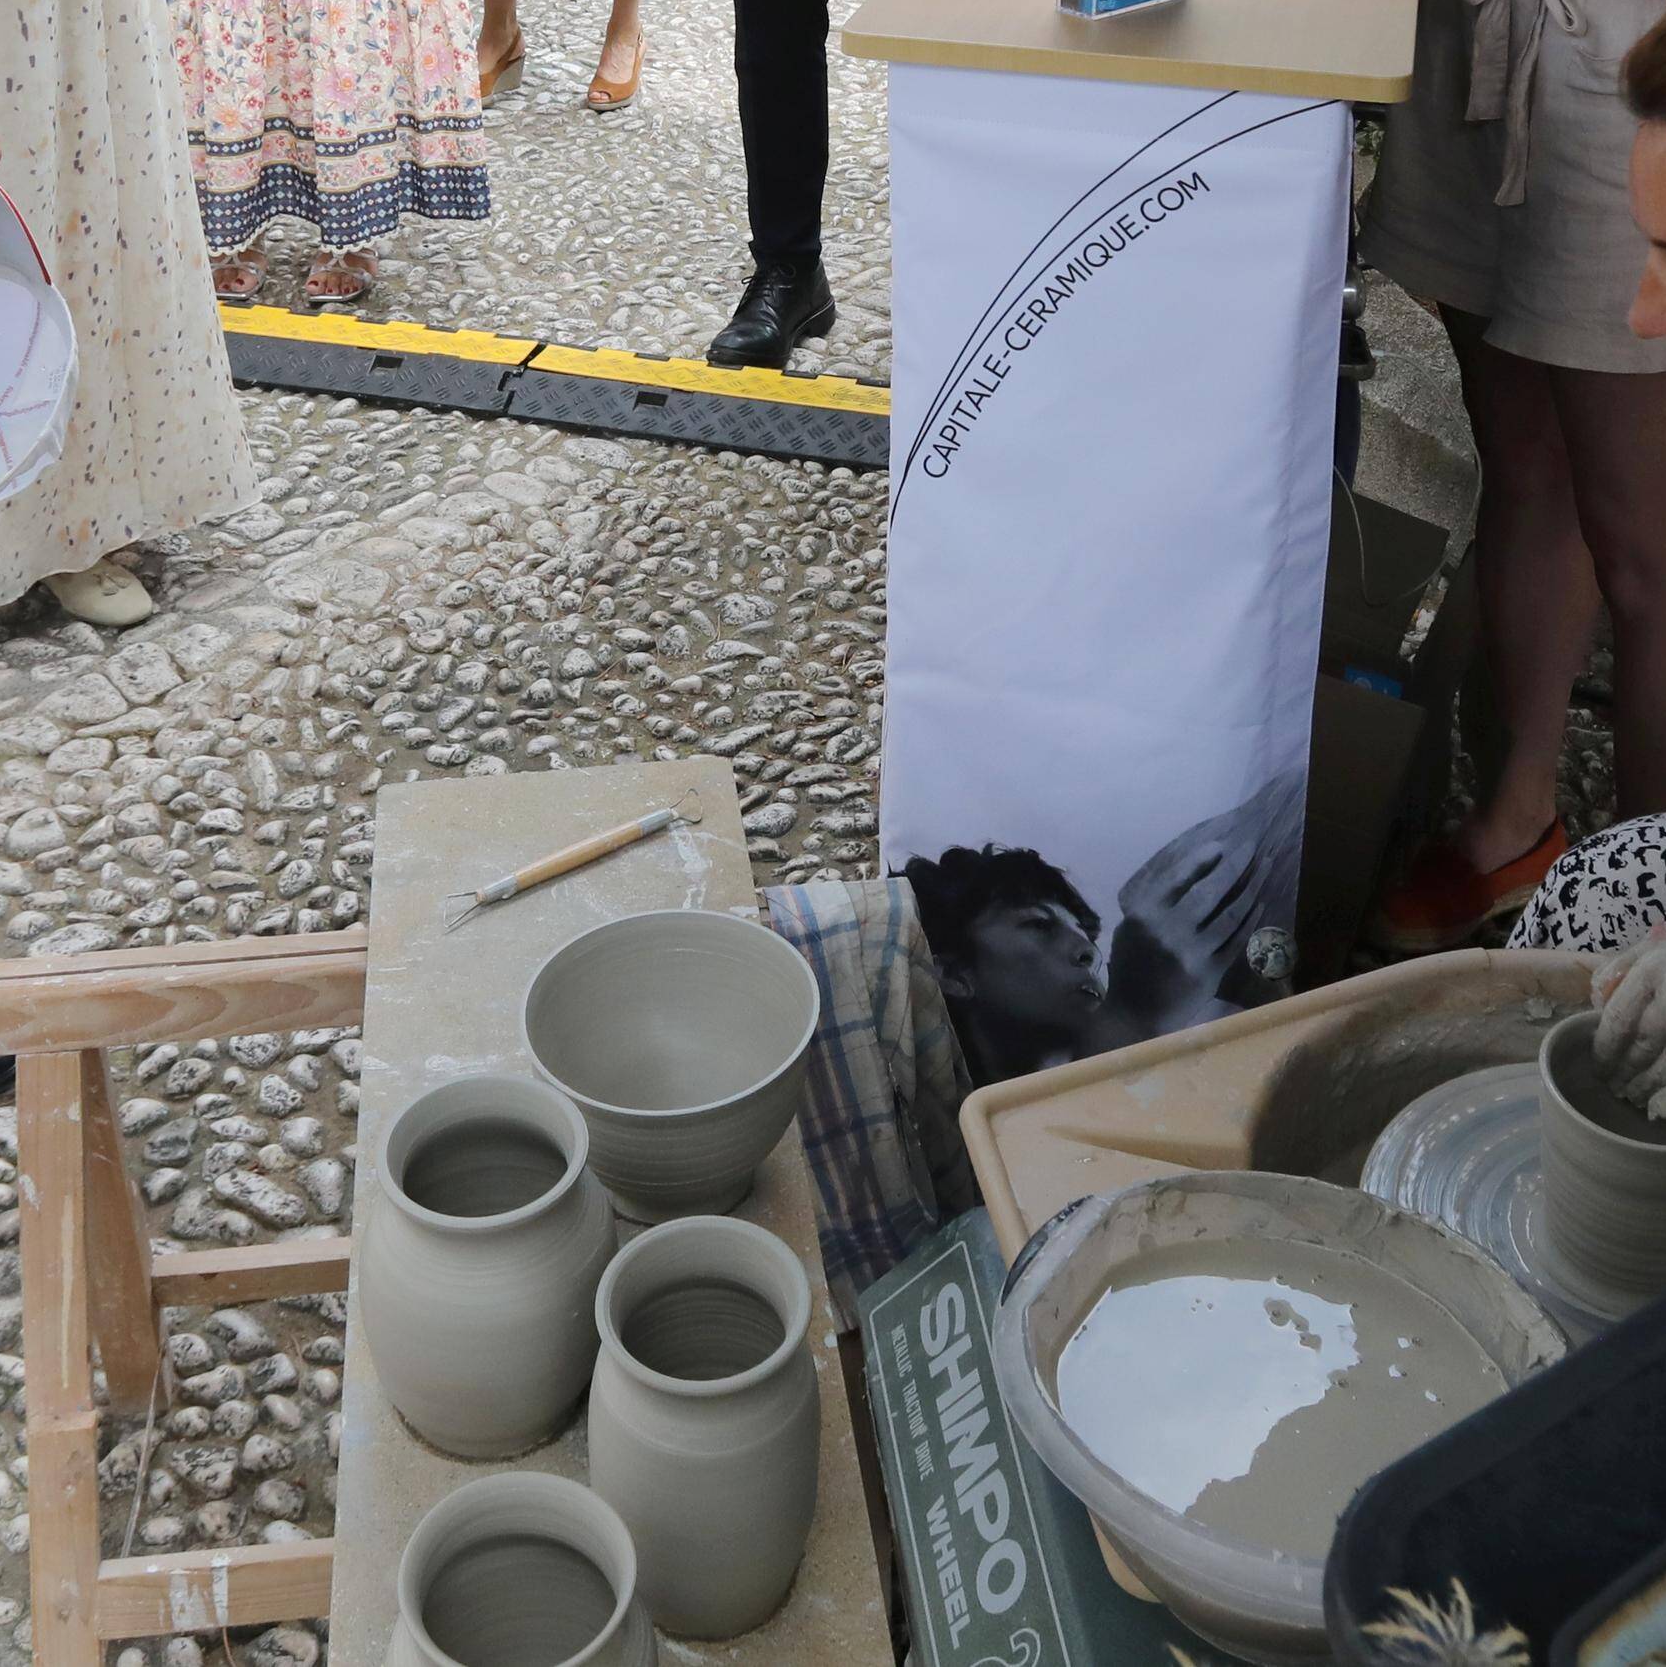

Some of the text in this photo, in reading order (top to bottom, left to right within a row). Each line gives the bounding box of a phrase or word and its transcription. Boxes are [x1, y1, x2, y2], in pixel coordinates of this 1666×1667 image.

[923, 171, 1211, 479] CAPITALE-CERAMIQUE.COM
[889, 1322, 911, 1379] METALLIC
[914, 1440, 936, 1482] DRIVE
[919, 1281, 1028, 1615] SHIMPO
[925, 1494, 972, 1650] WHEEL
